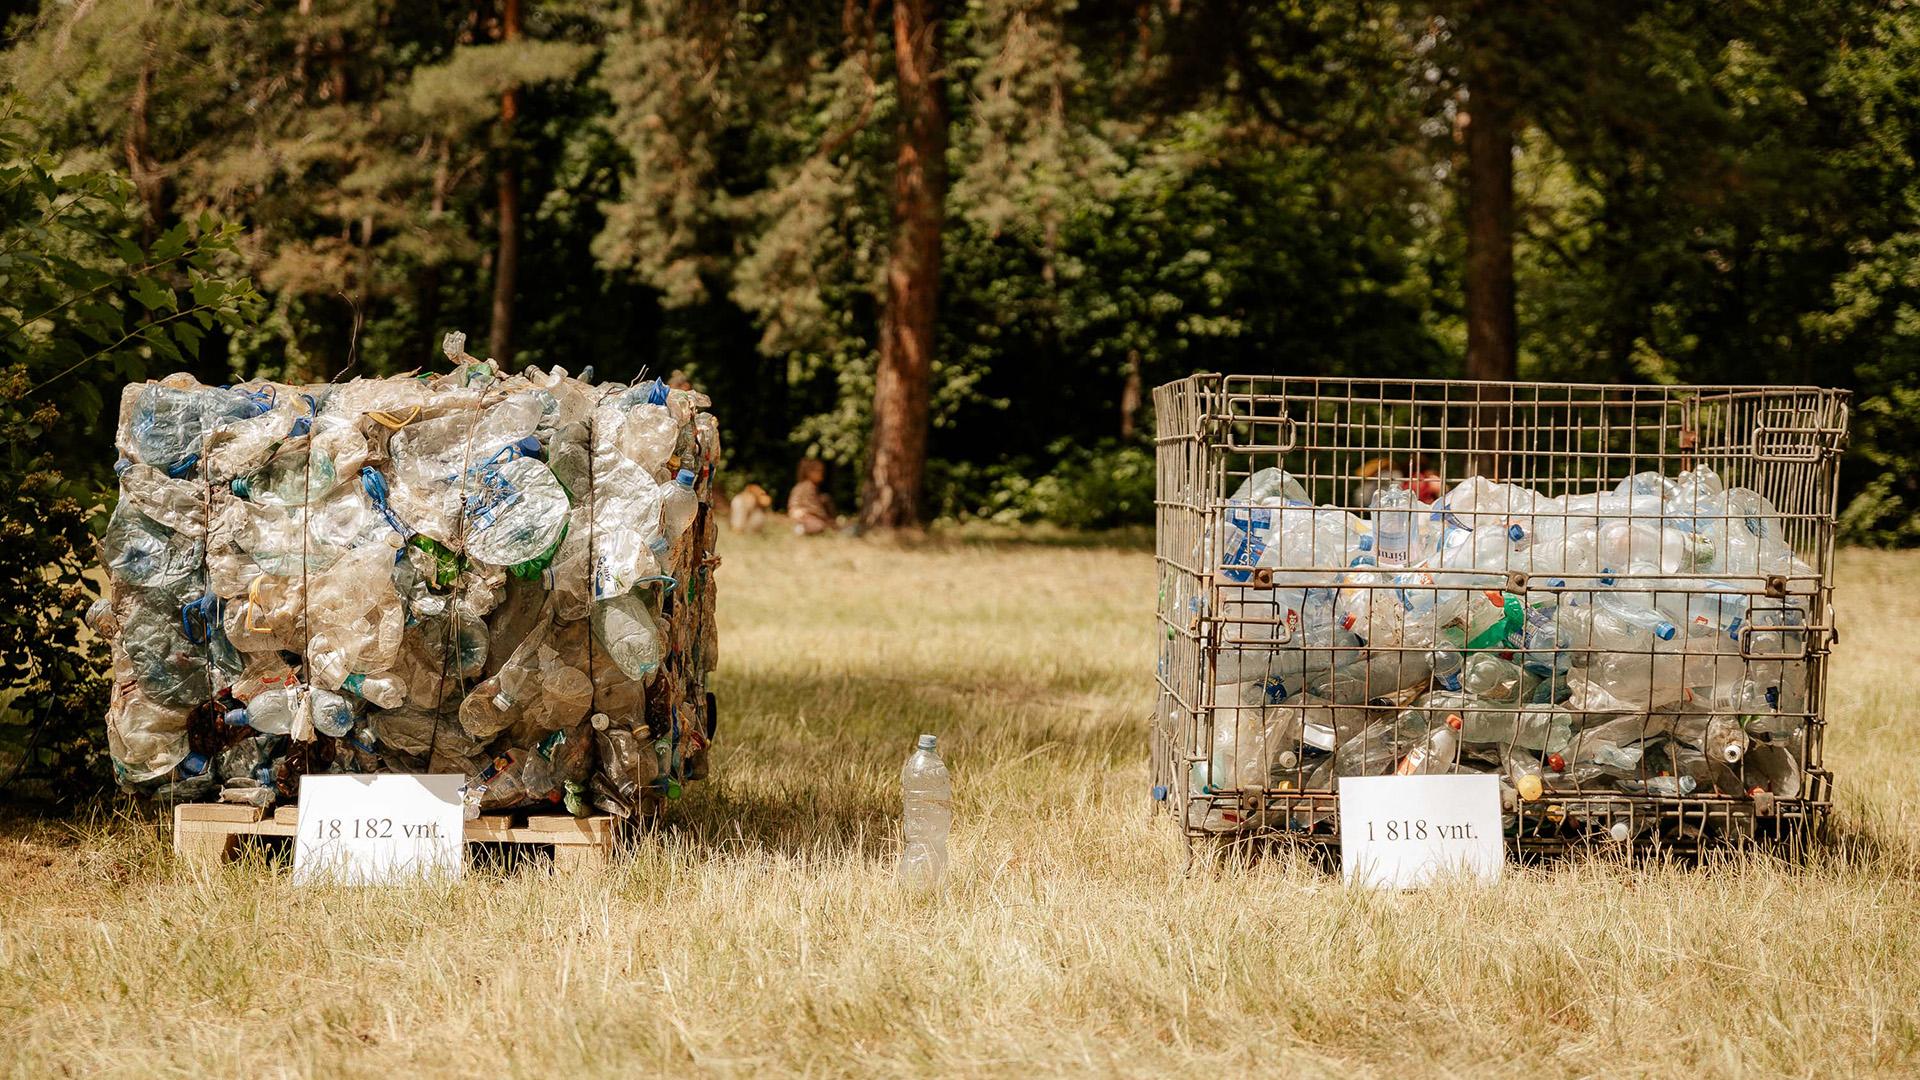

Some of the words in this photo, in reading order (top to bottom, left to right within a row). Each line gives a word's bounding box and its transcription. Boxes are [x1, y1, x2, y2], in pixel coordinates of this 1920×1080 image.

[317, 819, 342, 839] 18
[353, 818, 393, 839] 182
[402, 821, 446, 839] vnt.
[1367, 821, 1376, 841] 1
[1387, 820, 1428, 840] 818
[1436, 822, 1479, 840] vnt.
